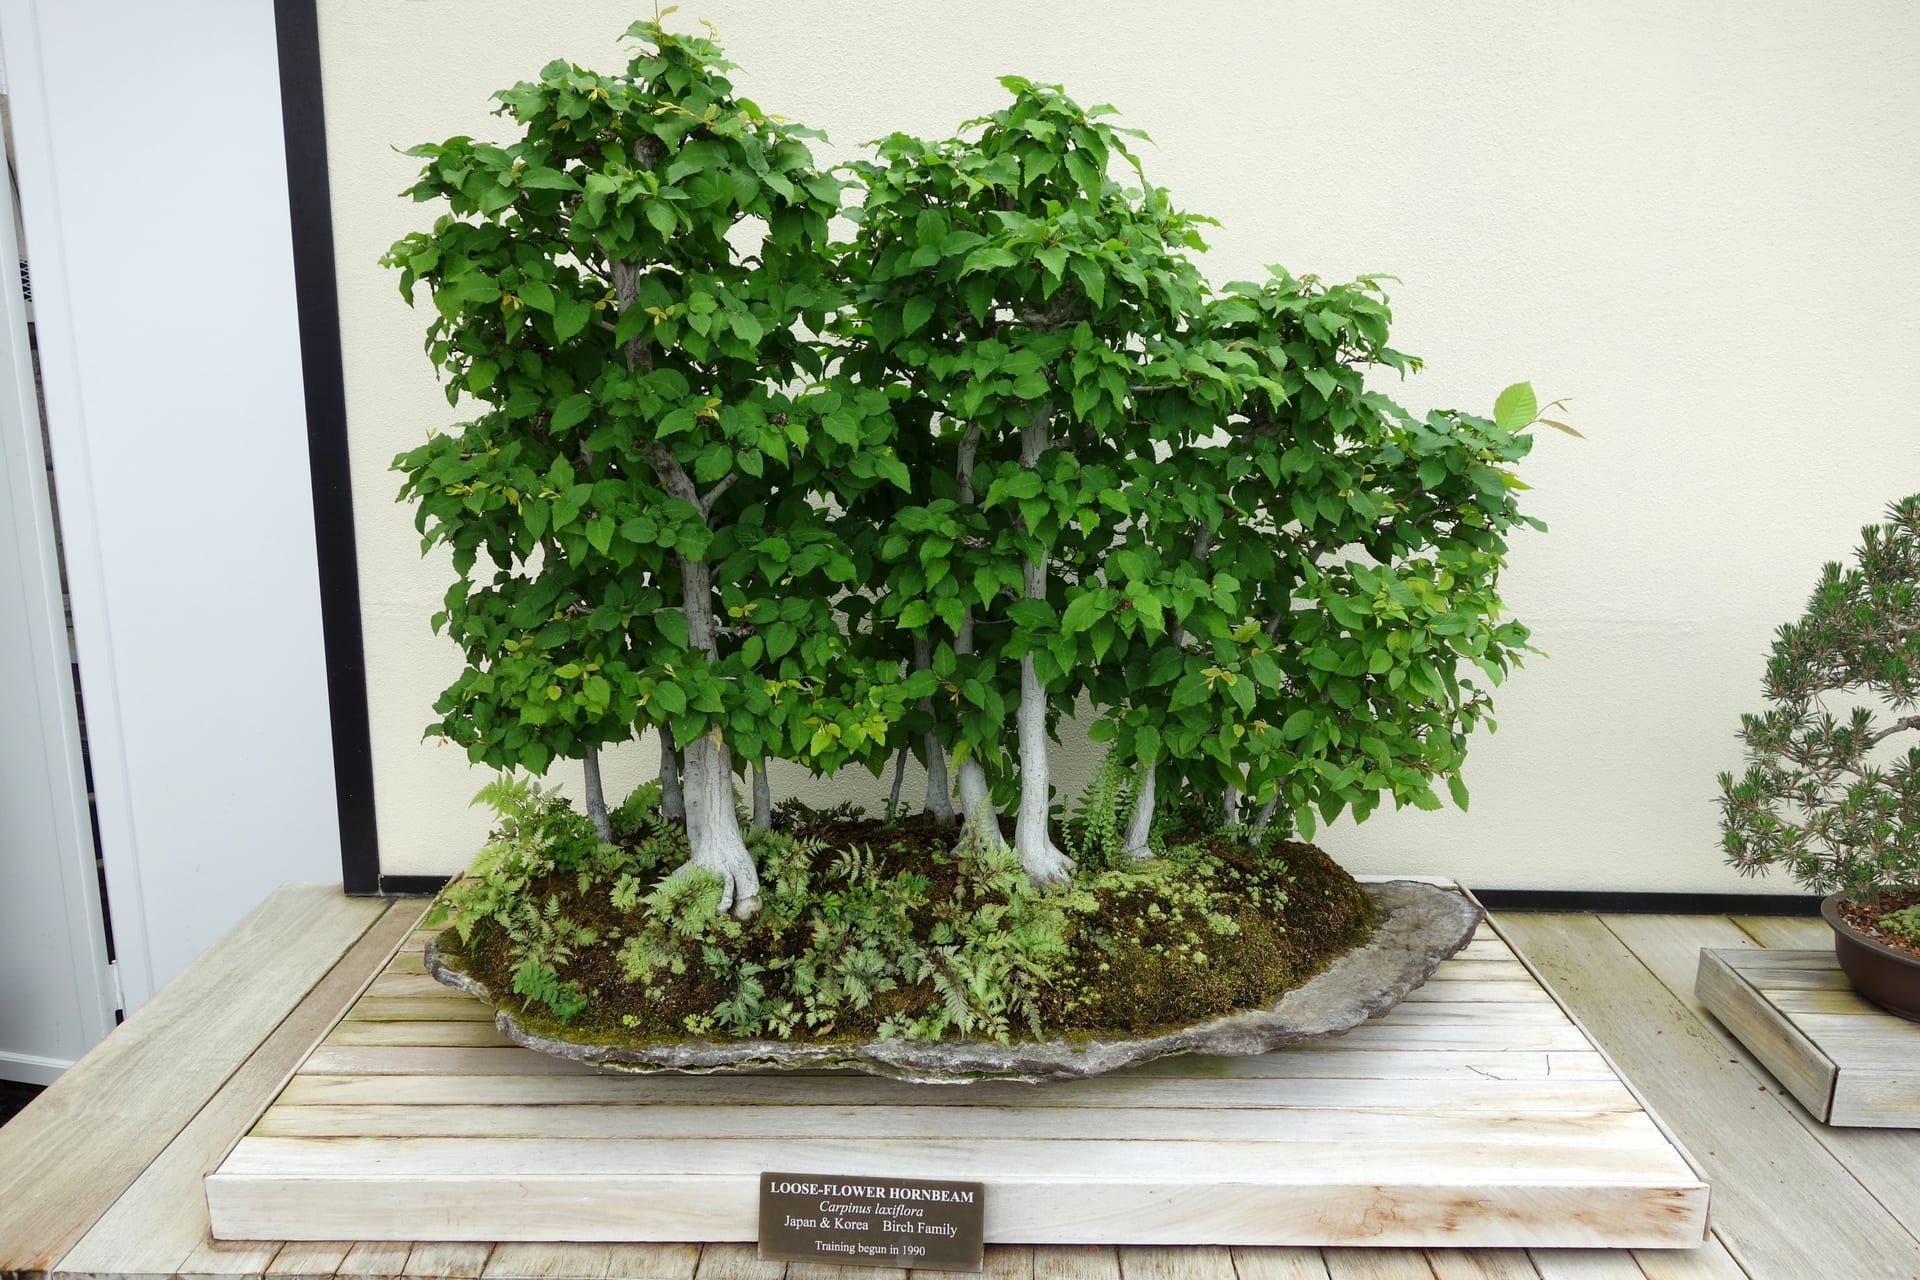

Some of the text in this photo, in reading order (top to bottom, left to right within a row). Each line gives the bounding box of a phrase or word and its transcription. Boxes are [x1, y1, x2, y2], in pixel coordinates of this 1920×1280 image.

[770, 1181, 974, 1203] LOOSE-FLOWER HORNBEAM
[819, 1200, 924, 1218] Carpinus laxiflora
[784, 1215, 958, 1238] Japan & Korea Birch Family
[815, 1240, 926, 1256] Training begun in 1990
